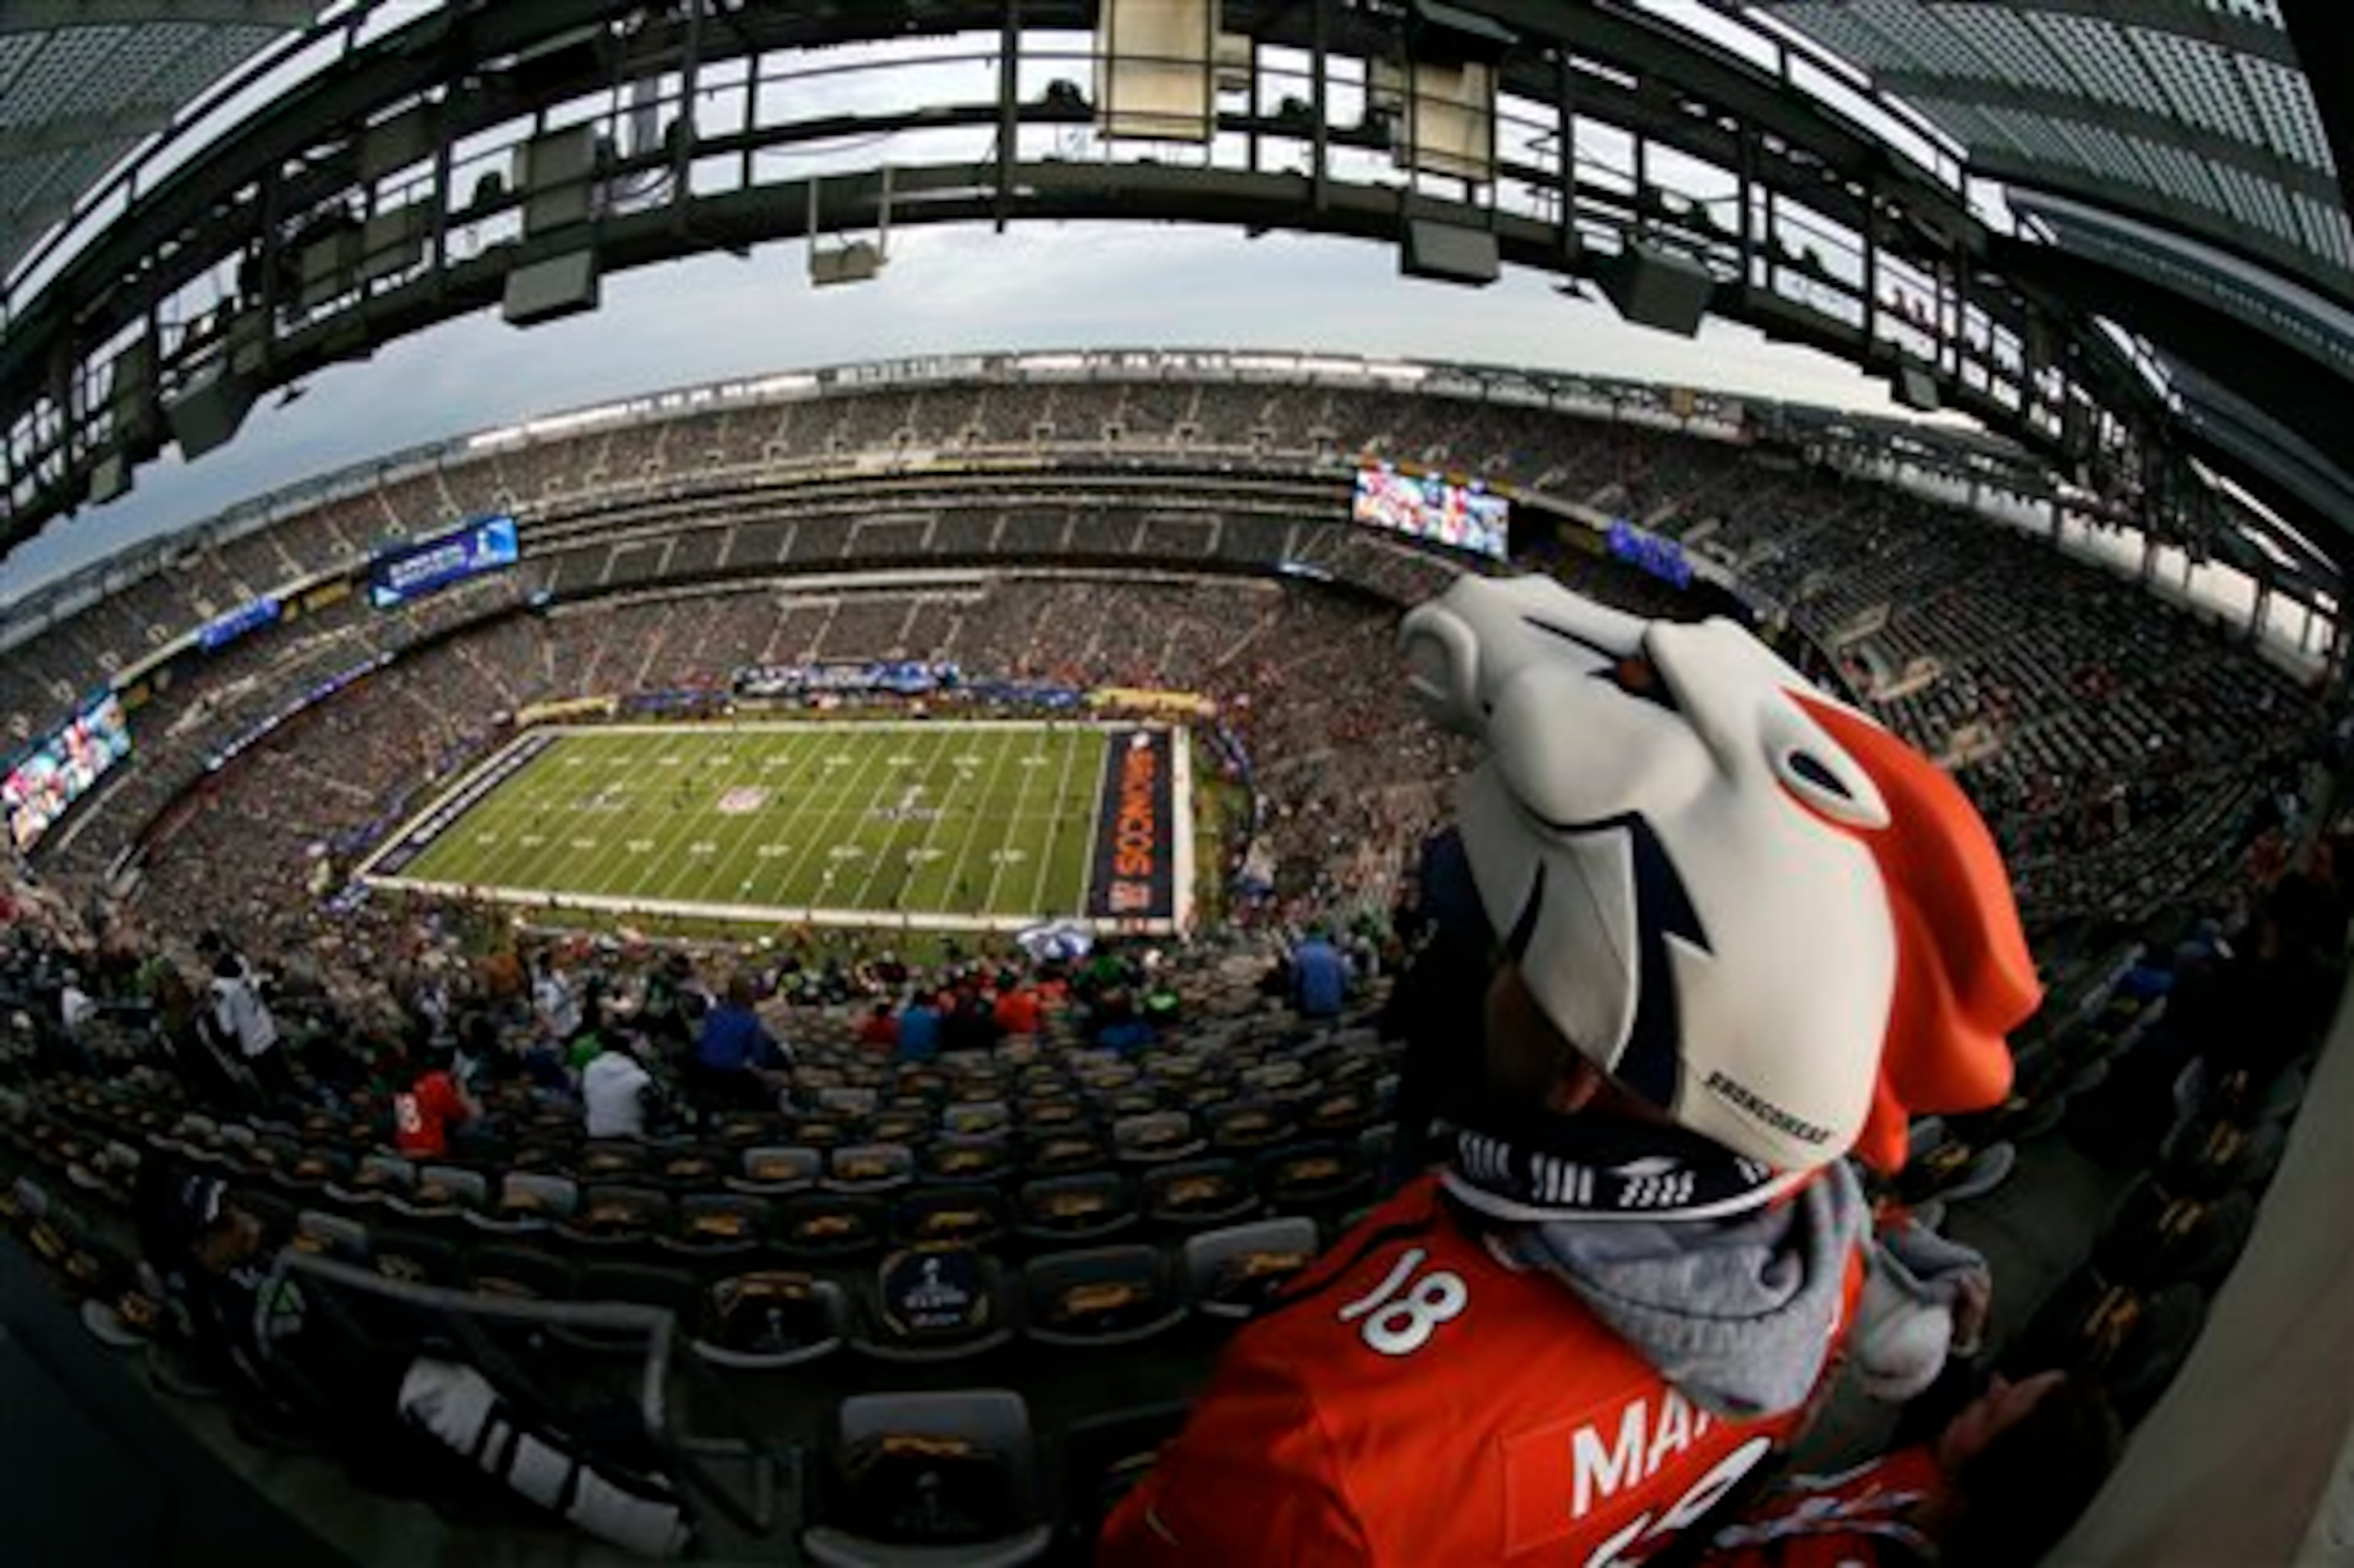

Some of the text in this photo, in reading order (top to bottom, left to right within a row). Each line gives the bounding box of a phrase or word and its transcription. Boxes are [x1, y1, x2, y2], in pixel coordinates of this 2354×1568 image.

[1112, 747, 1156, 877] BRONCOS
[1338, 1247, 1469, 1355] 18
[1570, 1384, 1710, 1520] MA
